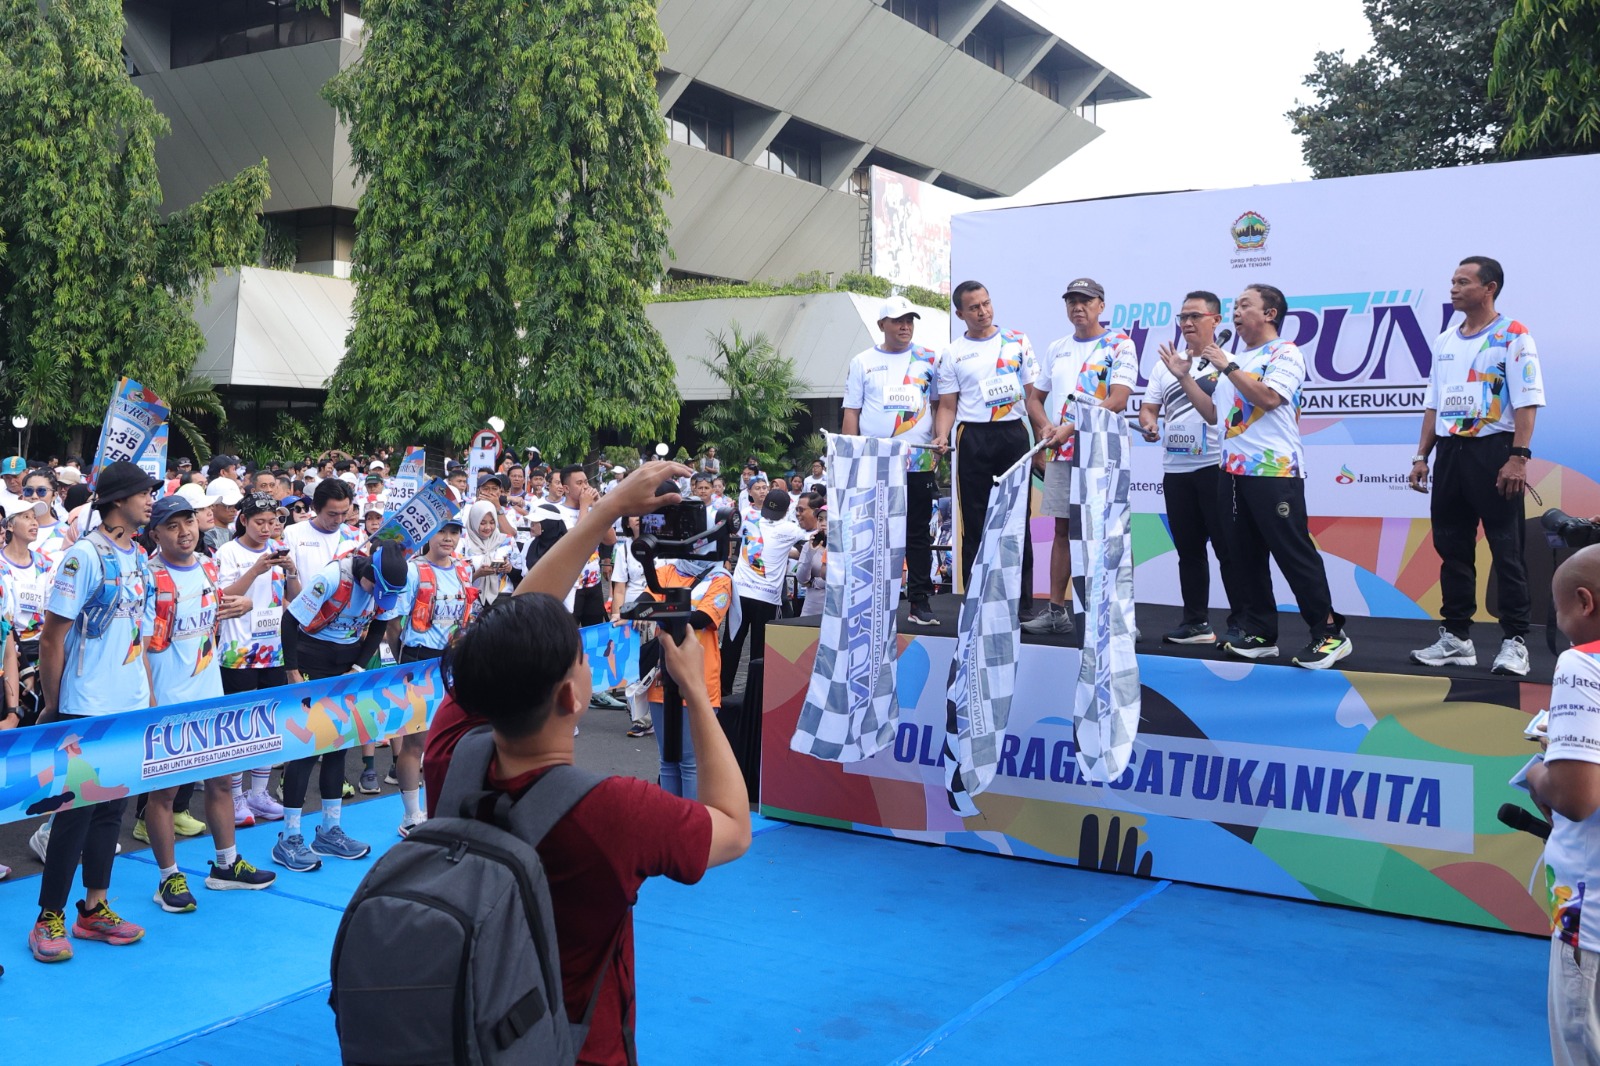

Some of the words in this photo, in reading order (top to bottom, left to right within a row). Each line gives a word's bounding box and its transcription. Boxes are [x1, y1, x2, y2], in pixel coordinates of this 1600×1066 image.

[1111, 301, 1171, 329] DPRD
[988, 384, 1014, 396] 01134
[889, 394, 915, 402] 00001
[1338, 392, 1425, 408] KERUKUN
[1445, 395, 1474, 406] 00019
[124, 427, 141, 439] SUB
[1169, 434, 1196, 443] 00009
[1129, 481, 1163, 494] ateng
[395, 514, 422, 543] ACER
[20, 591, 42, 602] 00875
[257, 617, 280, 628] 00802
[1571, 674, 1600, 691] Jate
[1569, 703, 1585, 711] BKK
[1586, 706, 1600, 714] JAT
[144, 718, 209, 761] FUN
[214, 701, 280, 747] RUN
[143, 764, 170, 775] BERLARI
[170, 759, 193, 770] UNTUK
[194, 751, 231, 764] PERSATUAN
[231, 748, 245, 757] DAN
[246, 739, 282, 753] KERUKUNAN
